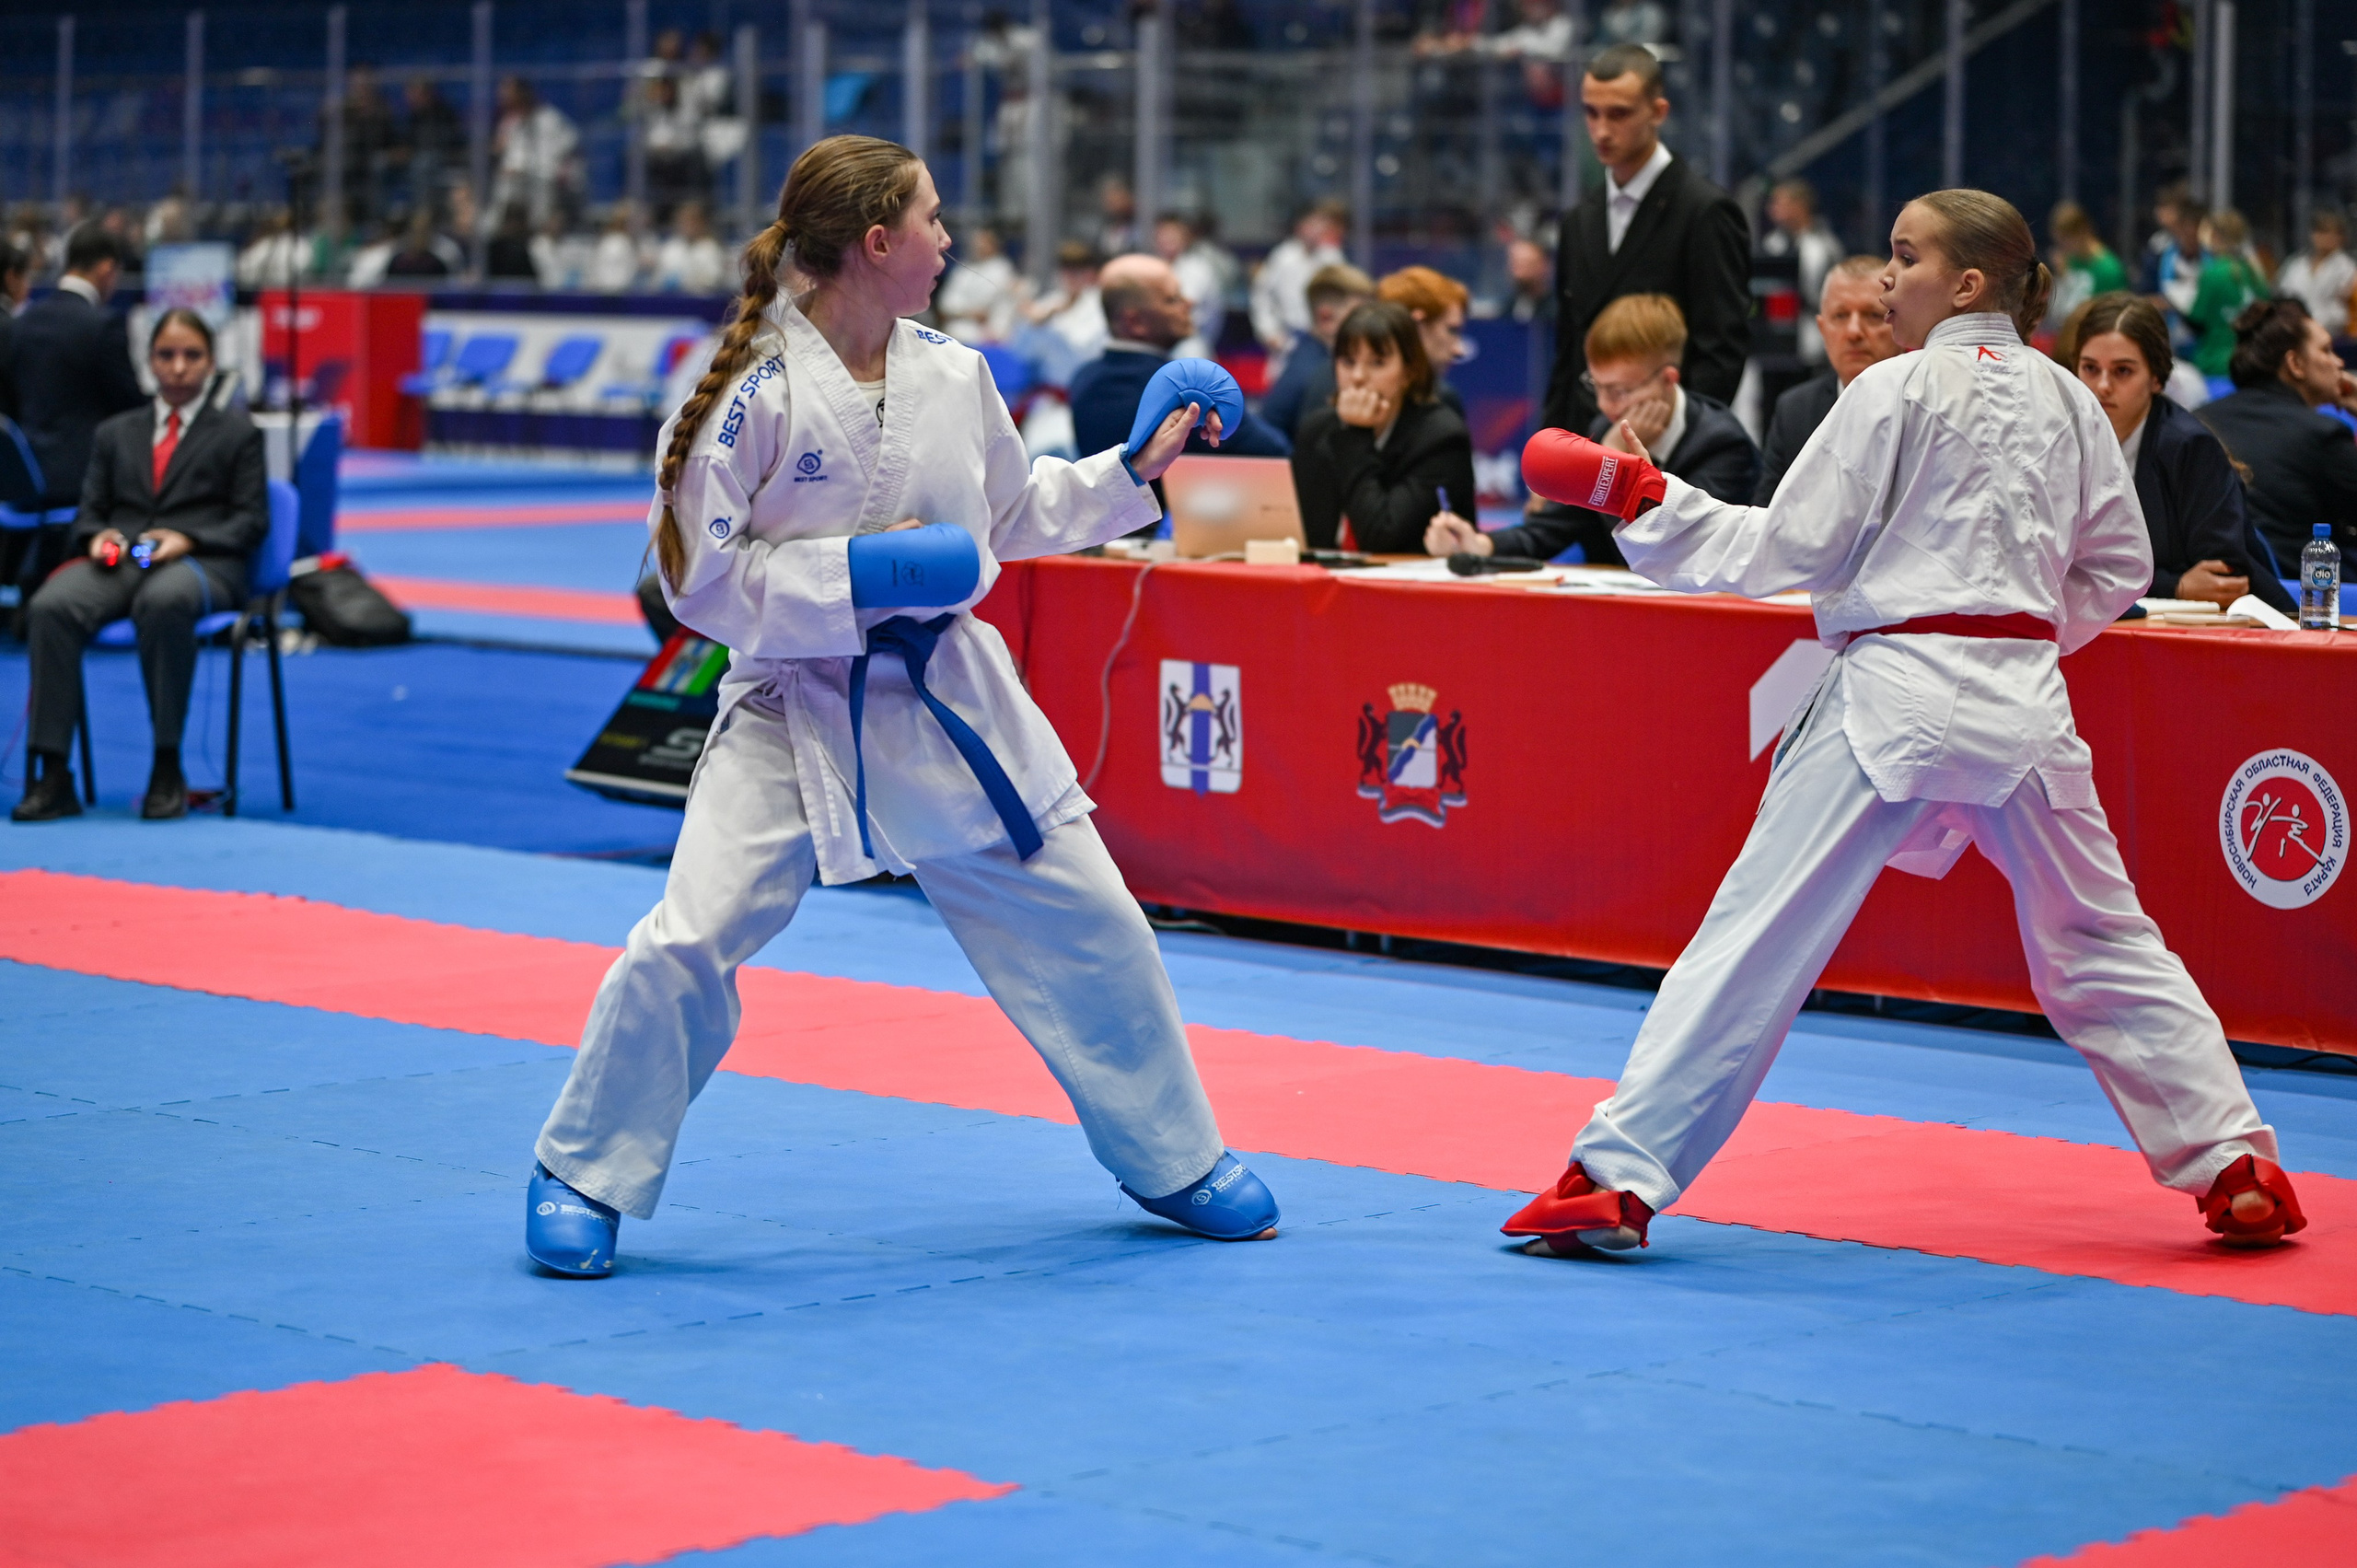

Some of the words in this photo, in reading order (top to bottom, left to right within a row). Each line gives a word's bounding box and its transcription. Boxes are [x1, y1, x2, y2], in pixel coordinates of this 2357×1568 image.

[718, 396, 747, 448] BEST
[740, 354, 786, 400] SPORT
[1591, 456, 1616, 506] FIGHTEXPERT
[2245, 754, 2310, 779] ОБЛАСТНАЯ
[2224, 778, 2258, 889] НОВОСИБИРСКАЯ
[2313, 772, 2343, 848] ФЕДЕРАЦИЯ
[2304, 855, 2337, 897] КАРАТЭ
